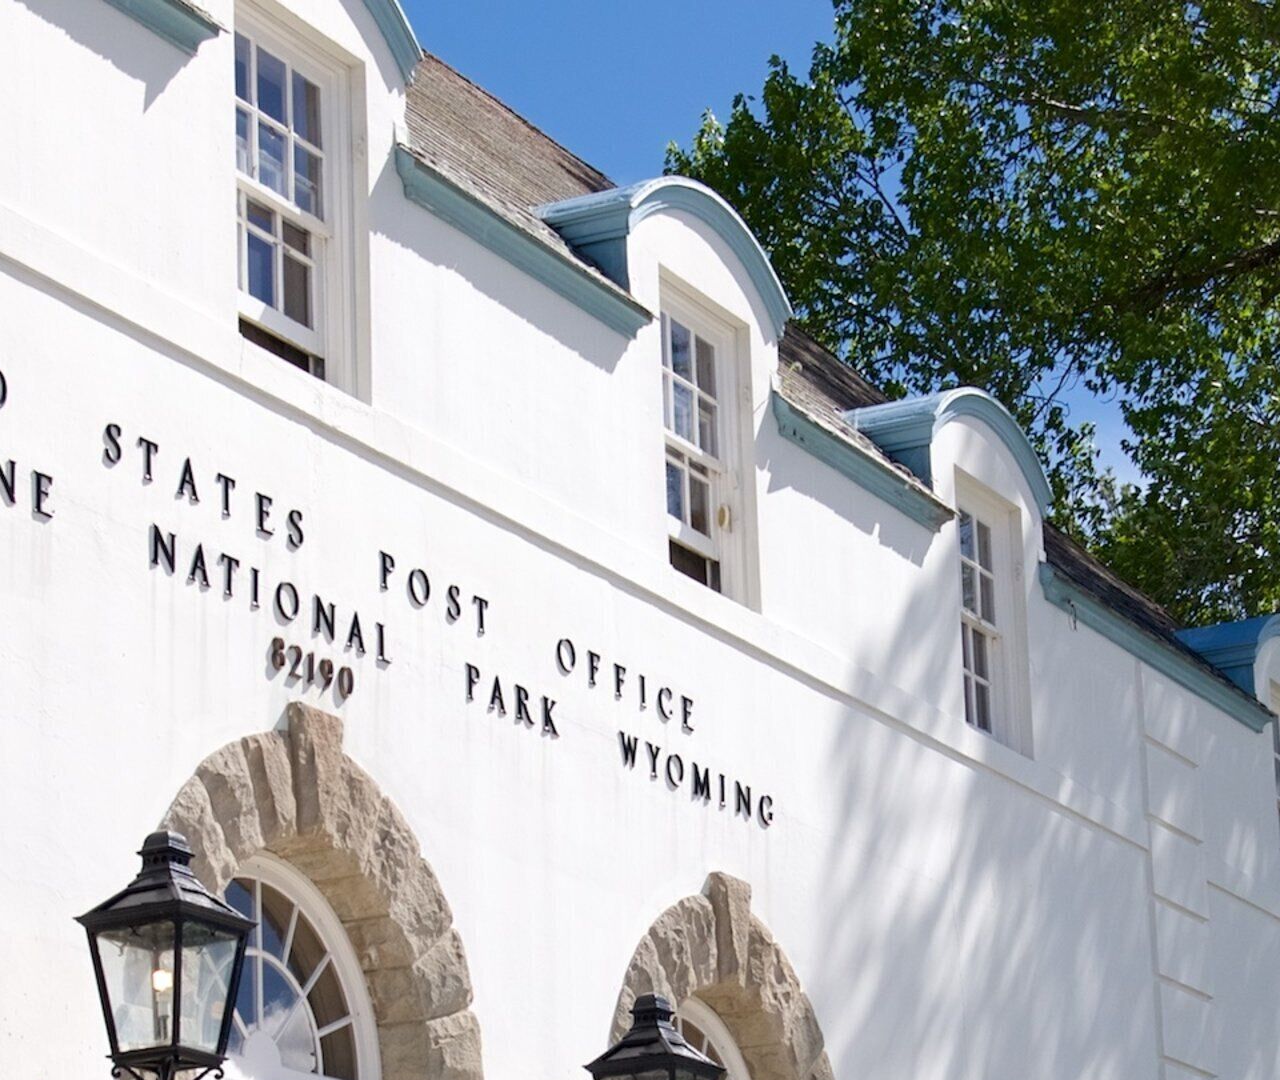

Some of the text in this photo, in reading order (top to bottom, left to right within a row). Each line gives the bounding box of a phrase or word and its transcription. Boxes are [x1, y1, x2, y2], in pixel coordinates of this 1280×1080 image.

[104, 422, 305, 548] STATES
[378, 550, 489, 635] POST
[556, 637, 696, 734] OFFICE
[150, 523, 391, 665] NATIONAL
[465, 661, 559, 738] PARK
[619, 730, 774, 827] WYOMING
[271, 636, 354, 700] 82190
